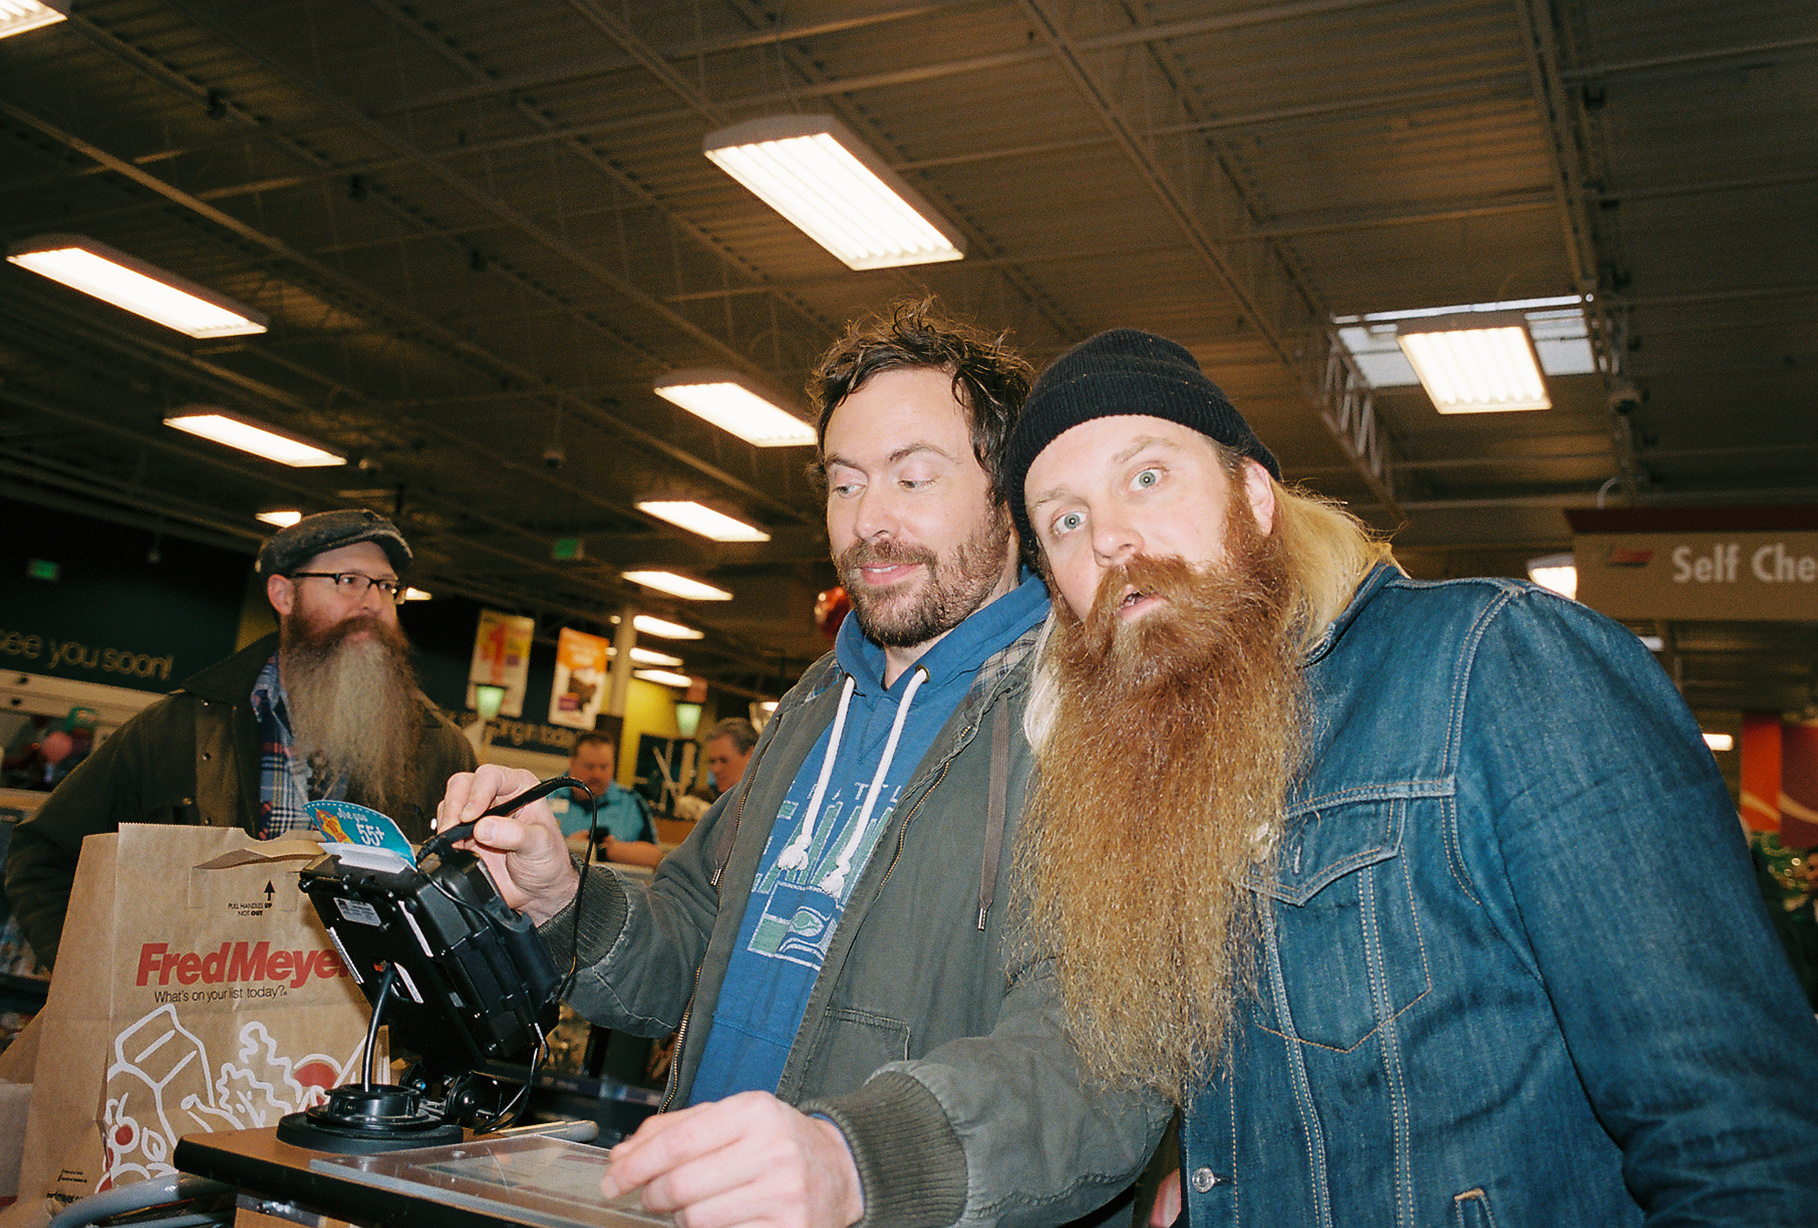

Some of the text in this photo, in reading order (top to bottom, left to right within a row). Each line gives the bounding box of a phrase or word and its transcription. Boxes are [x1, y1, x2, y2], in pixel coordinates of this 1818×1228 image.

[1672, 543, 1816, 583] Self Che
[0, 630, 174, 681] ee you soon!
[356, 823, 385, 847] 55+
[154, 990, 189, 1003] What's
[191, 991, 205, 1001] on
[206, 989, 227, 1003] your
[229, 986, 243, 999] list
